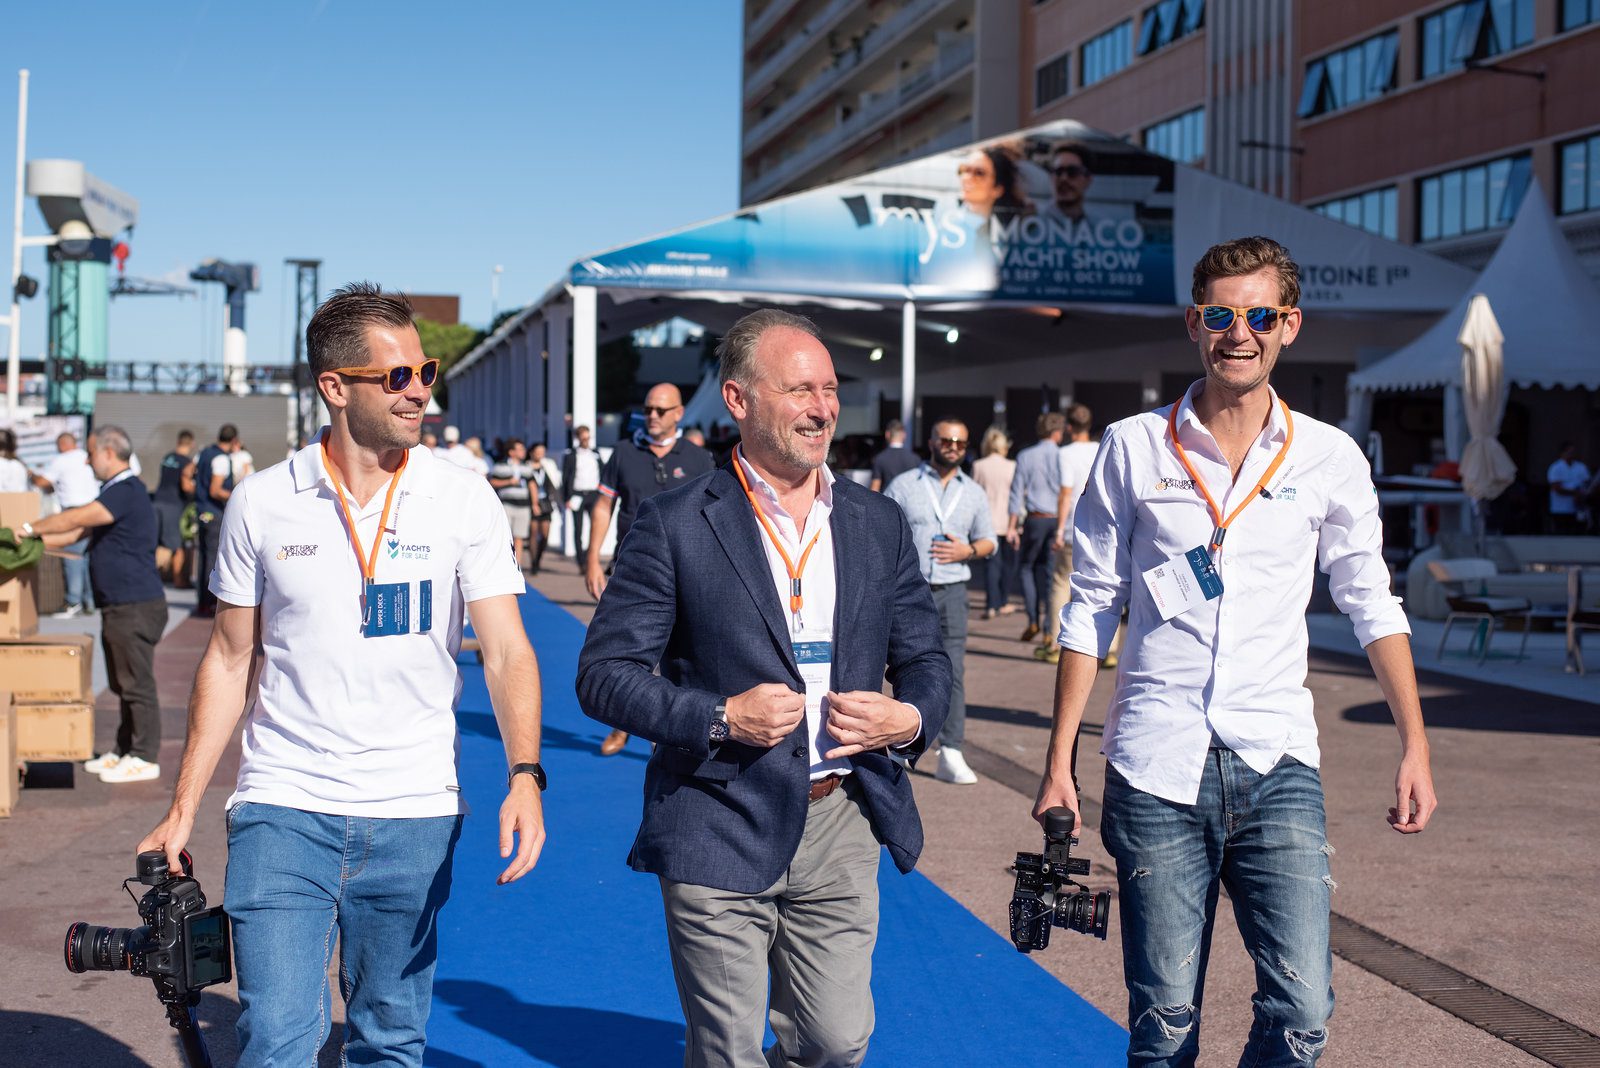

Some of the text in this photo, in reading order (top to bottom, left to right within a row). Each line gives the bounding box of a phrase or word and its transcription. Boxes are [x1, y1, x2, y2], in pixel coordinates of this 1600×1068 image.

[875, 206, 967, 264] mys
[990, 215, 1143, 248] MONACO
[992, 245, 1142, 270] YACHT SHOW
[1014, 268, 1041, 282] SEP
[1053, 270, 1071, 284] 01
[1074, 270, 1103, 284] OCT
[281, 544, 319, 552] NORTHROP
[400, 544, 431, 553] YACHTS
[284, 550, 316, 560] JOHNSON
[414, 552, 429, 560] SALE
